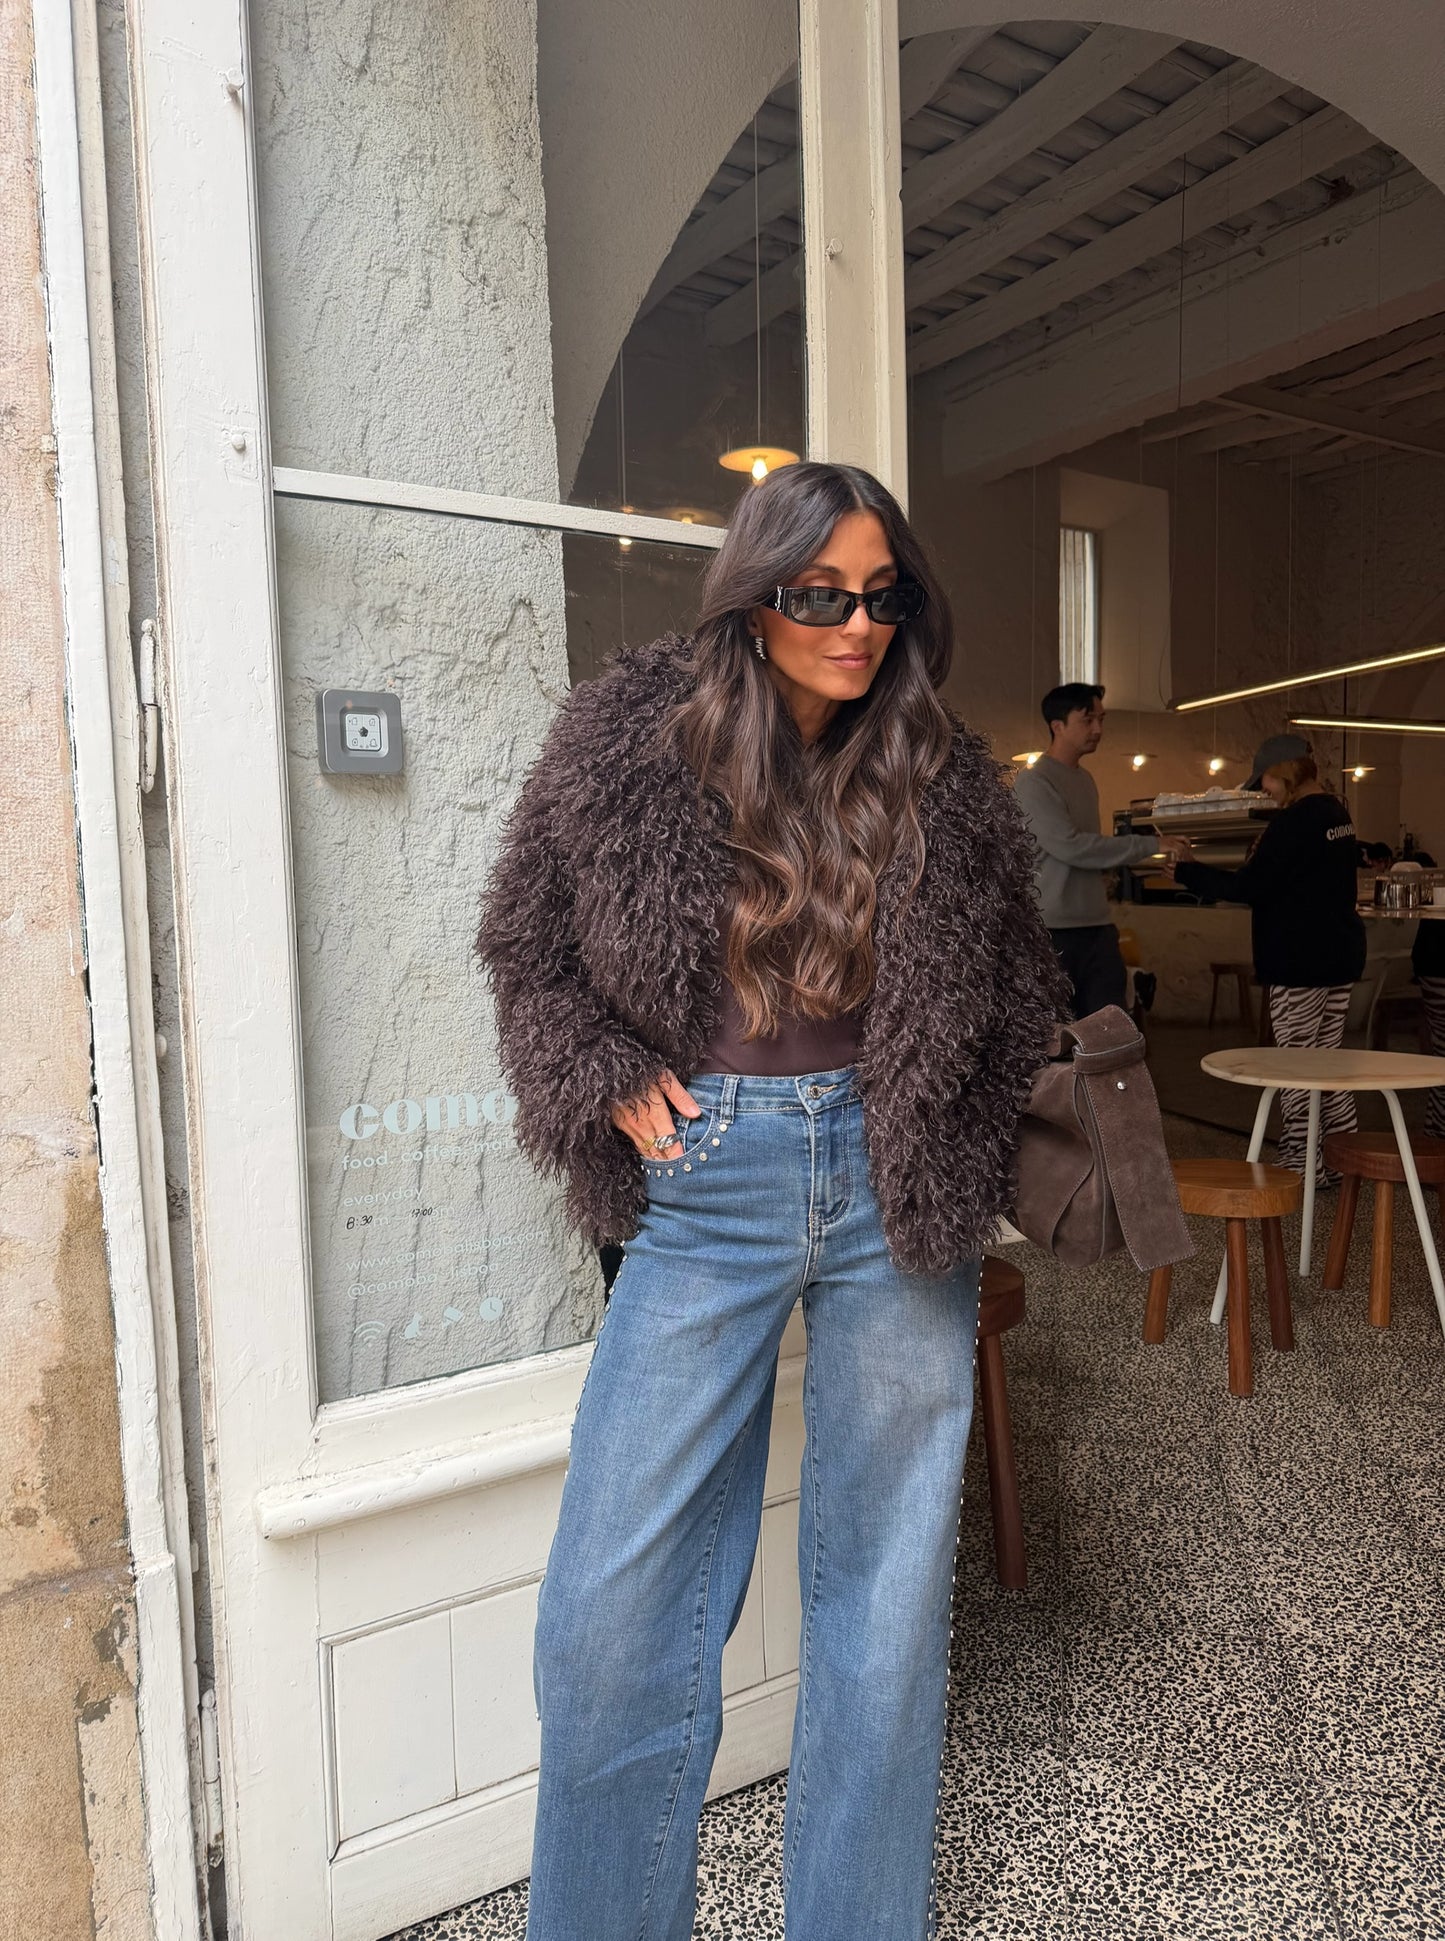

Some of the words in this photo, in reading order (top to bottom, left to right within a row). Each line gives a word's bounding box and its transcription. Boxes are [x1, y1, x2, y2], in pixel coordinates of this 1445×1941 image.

[339, 1089, 518, 1140] como
[343, 1186, 424, 1207] everyday
[346, 1215, 373, 1230] 8:30
